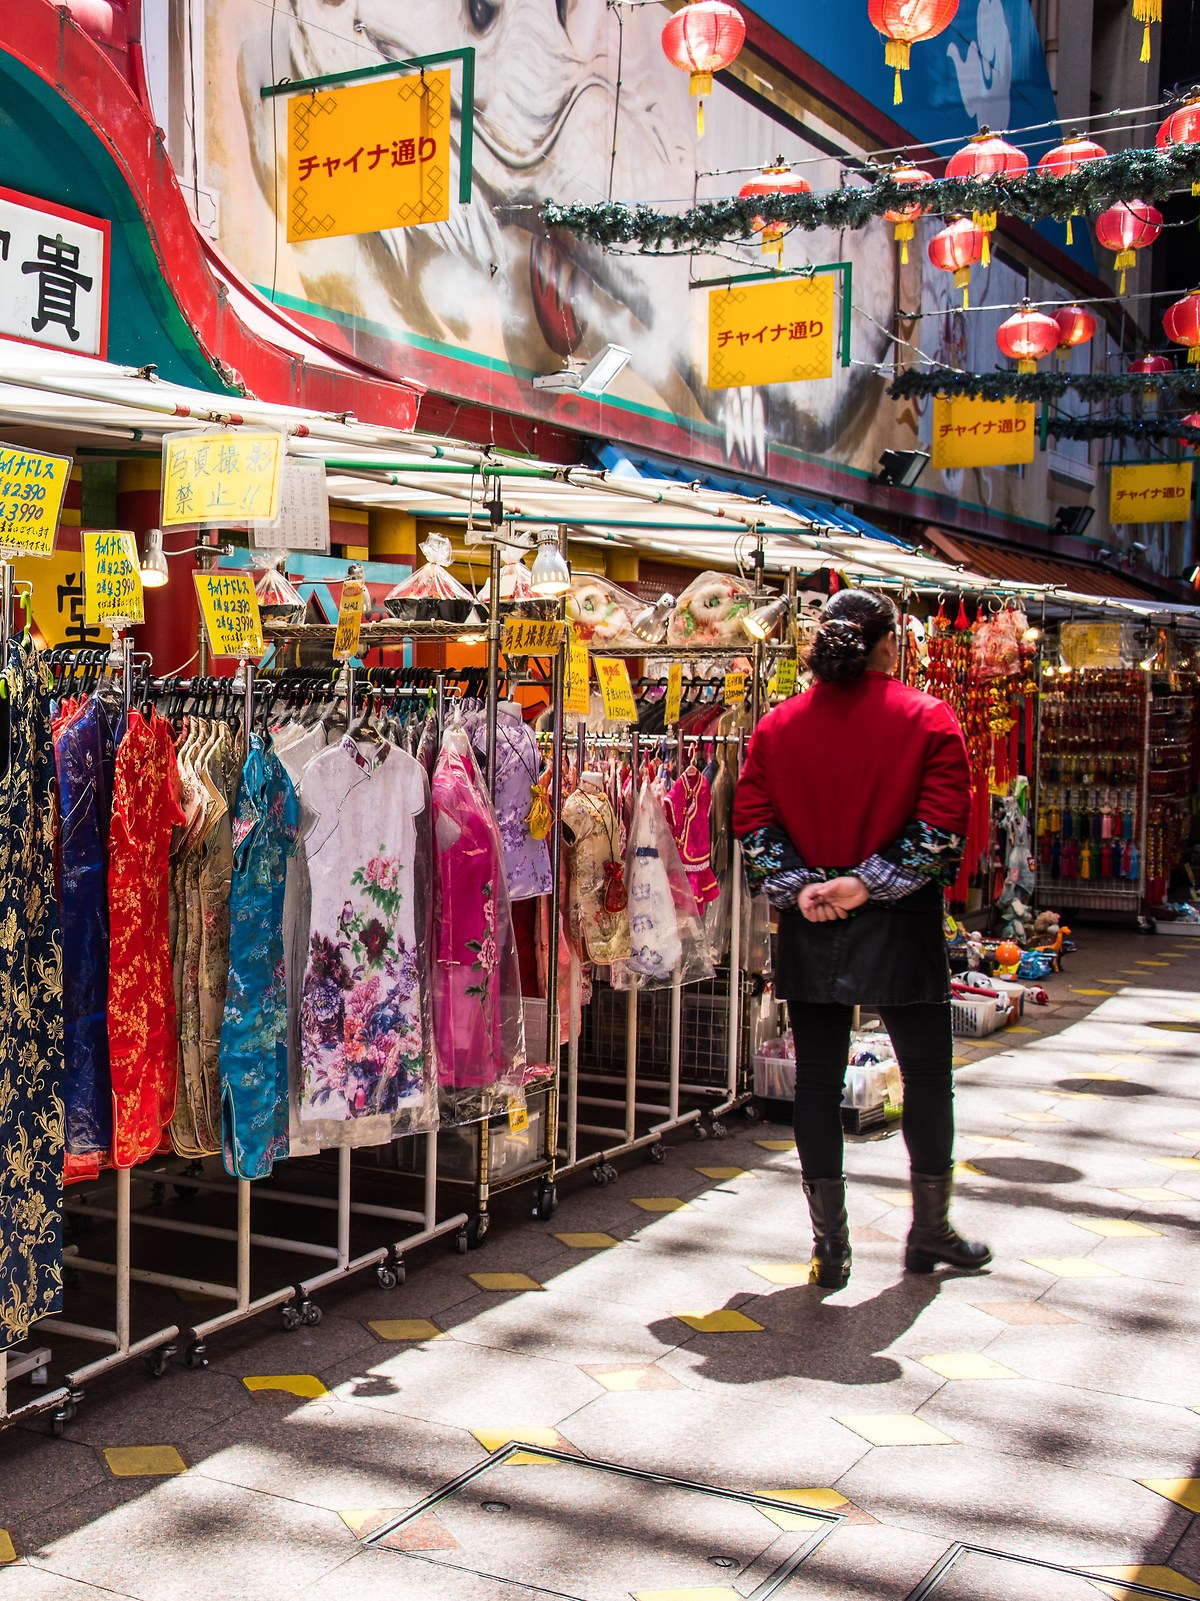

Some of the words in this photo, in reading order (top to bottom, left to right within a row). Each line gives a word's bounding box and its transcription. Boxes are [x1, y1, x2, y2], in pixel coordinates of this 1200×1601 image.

[298, 136, 437, 181] チャイナ通り
[717, 320, 823, 348] チャイナ通り
[939, 418, 1027, 437] チャイナ通り
[171, 443, 271, 479] 写真撮影
[1116, 487, 1186, 500] チャイナ通り
